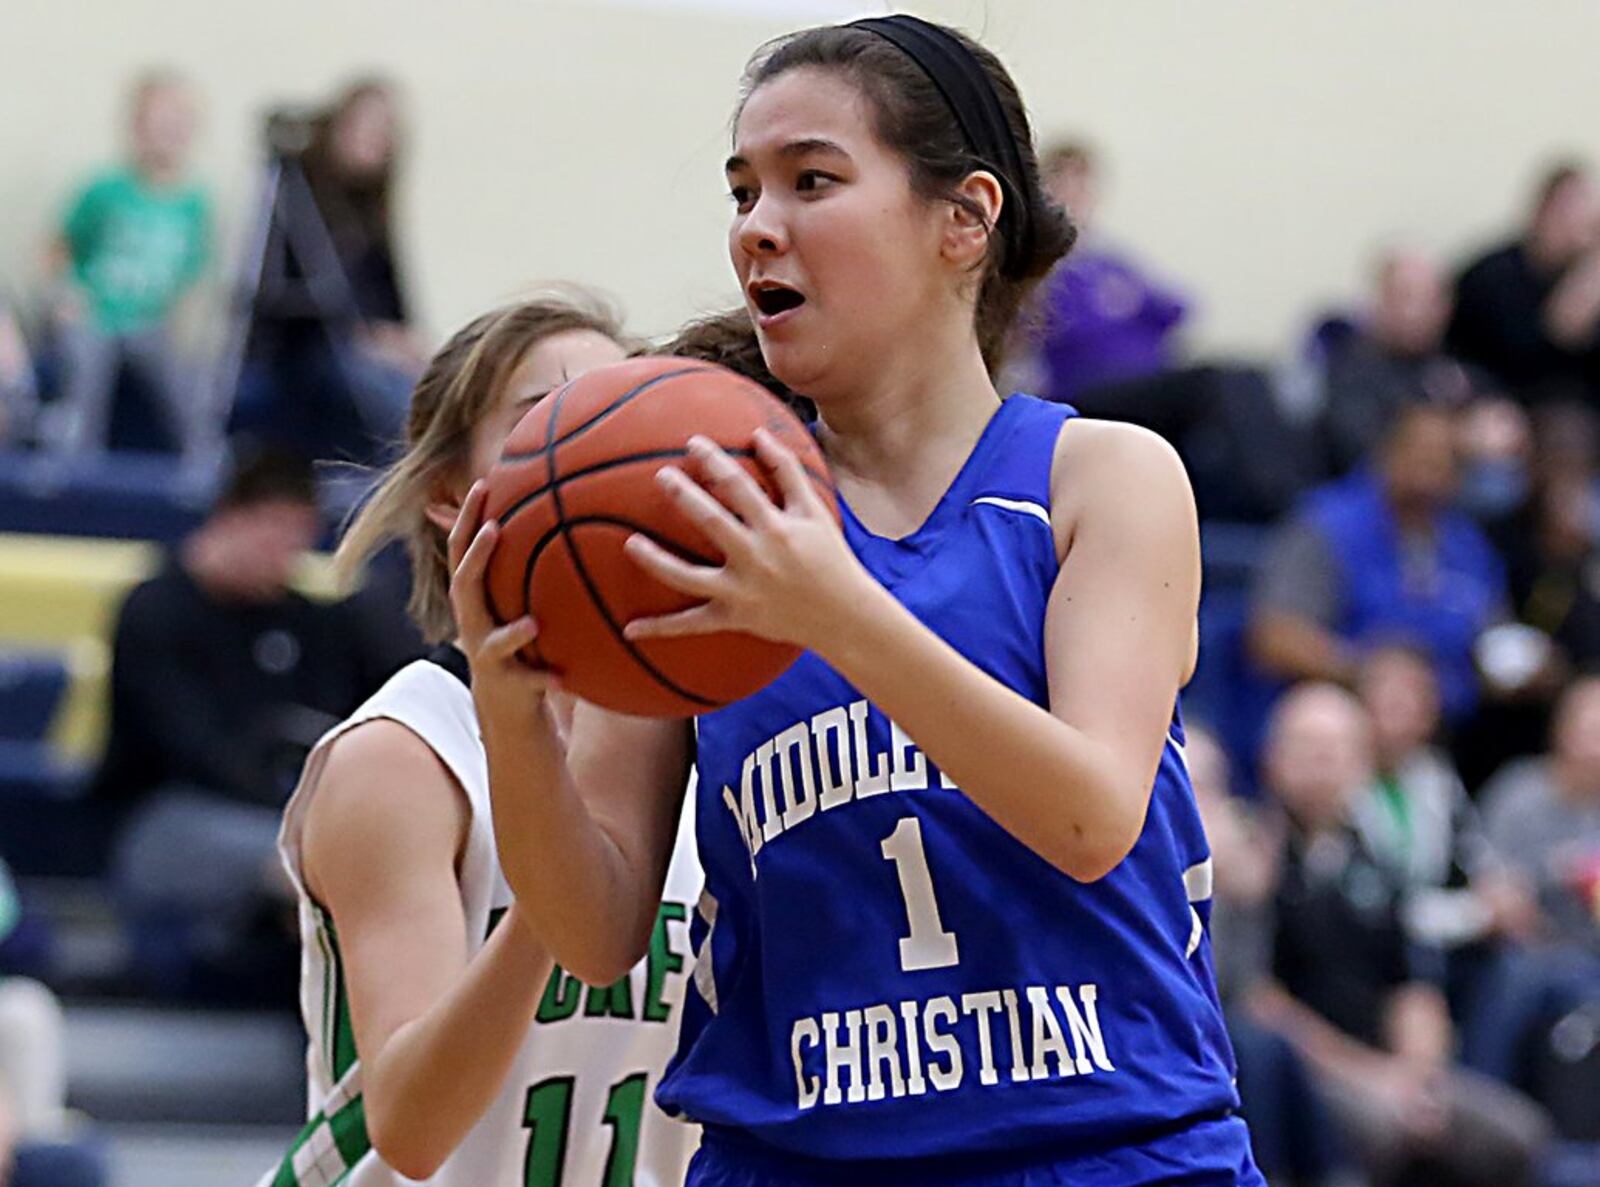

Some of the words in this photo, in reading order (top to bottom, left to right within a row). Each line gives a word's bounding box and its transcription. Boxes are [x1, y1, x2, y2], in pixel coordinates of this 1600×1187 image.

[722, 699, 969, 882] MIDDLE
[880, 816, 960, 972] 1
[790, 984, 1116, 1110] CHRISTIAN
